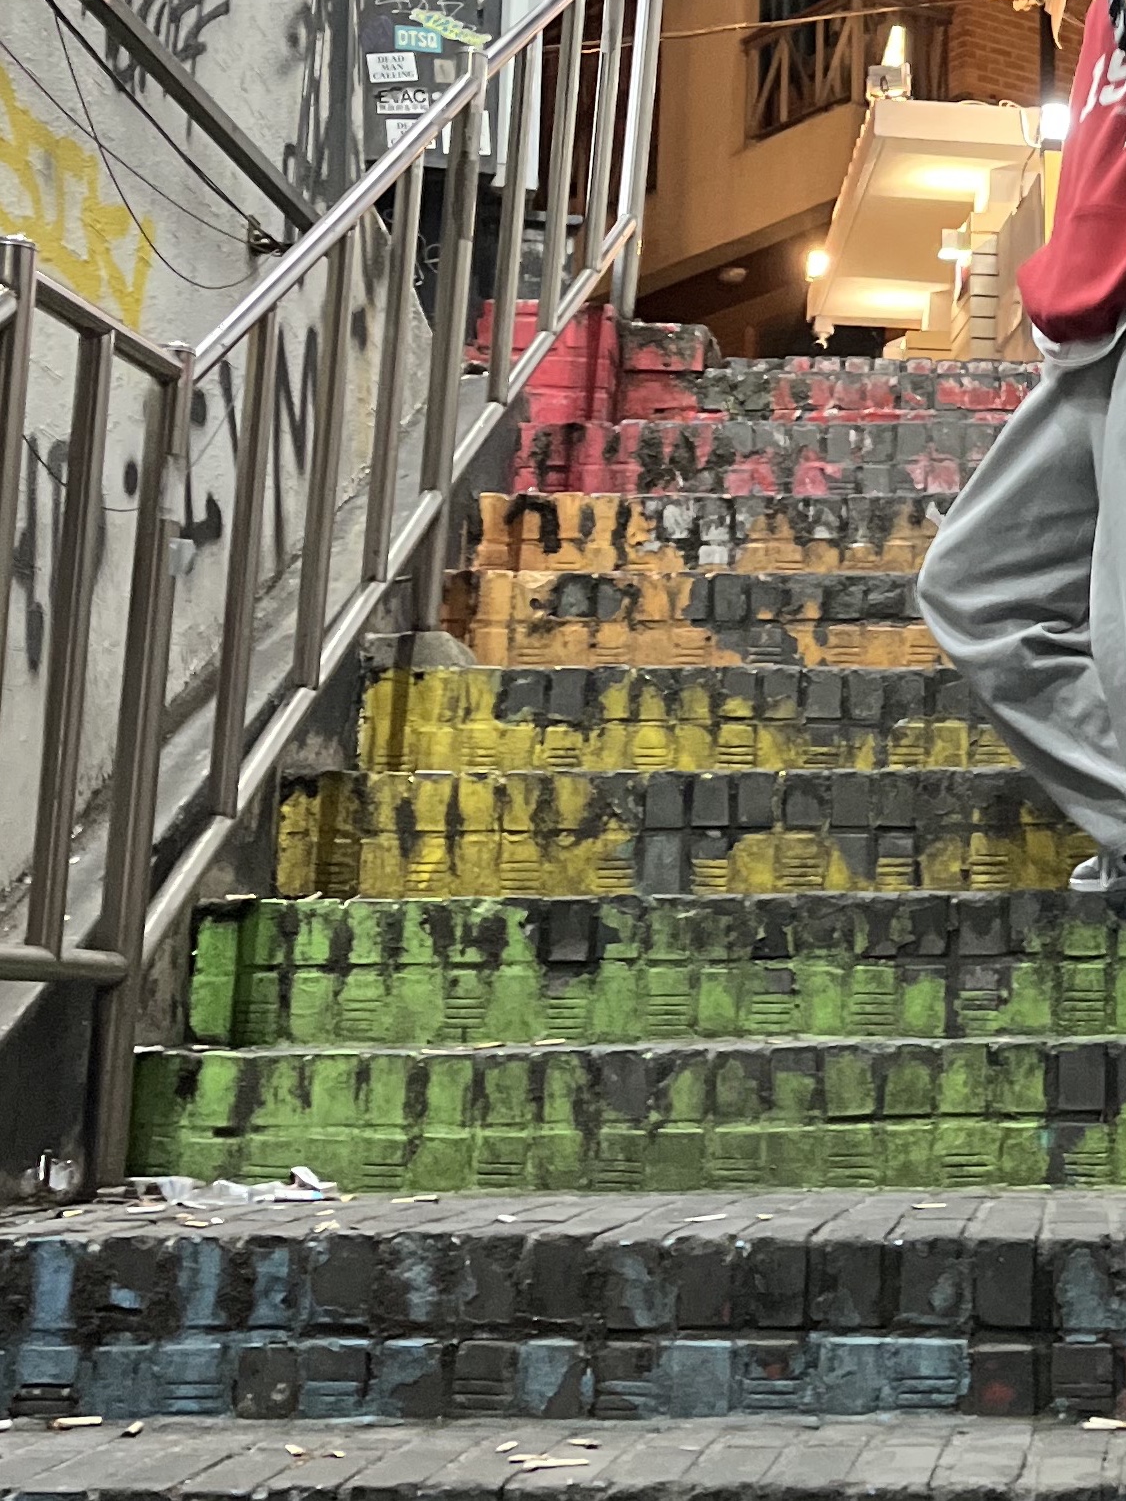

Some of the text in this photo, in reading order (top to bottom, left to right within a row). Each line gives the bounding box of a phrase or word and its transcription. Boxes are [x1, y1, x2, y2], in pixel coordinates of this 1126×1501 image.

[397, 30, 438, 49] DTSQ
[377, 55, 405, 65] DEAD
[372, 71, 416, 81] CALLING
[378, 89, 427, 104] EAC
